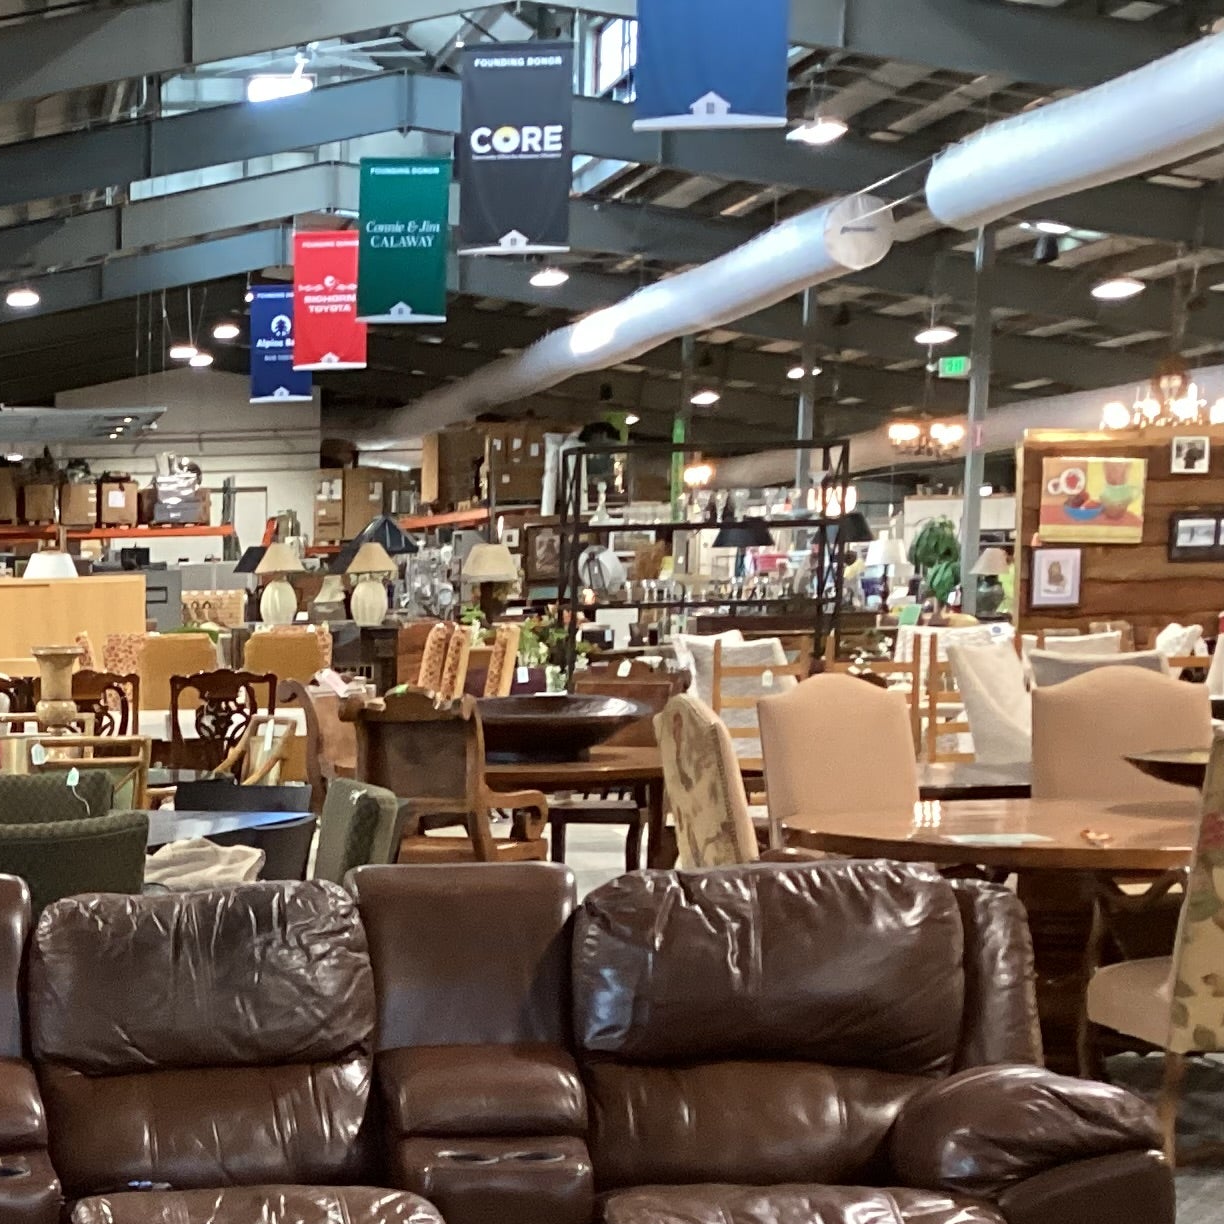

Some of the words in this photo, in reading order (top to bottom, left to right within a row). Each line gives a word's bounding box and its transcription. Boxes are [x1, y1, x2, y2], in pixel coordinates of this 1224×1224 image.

[474, 57, 525, 67] FOUNDING
[526, 56, 562, 66] DONOR
[470, 125, 563, 153] CORE
[366, 221, 405, 233] Connie
[407, 220, 418, 233] &
[419, 220, 440, 233] Jim
[370, 235, 435, 248] CALAWAY
[309, 304, 351, 313] TOYOTA
[256, 338, 284, 349] Alpine
